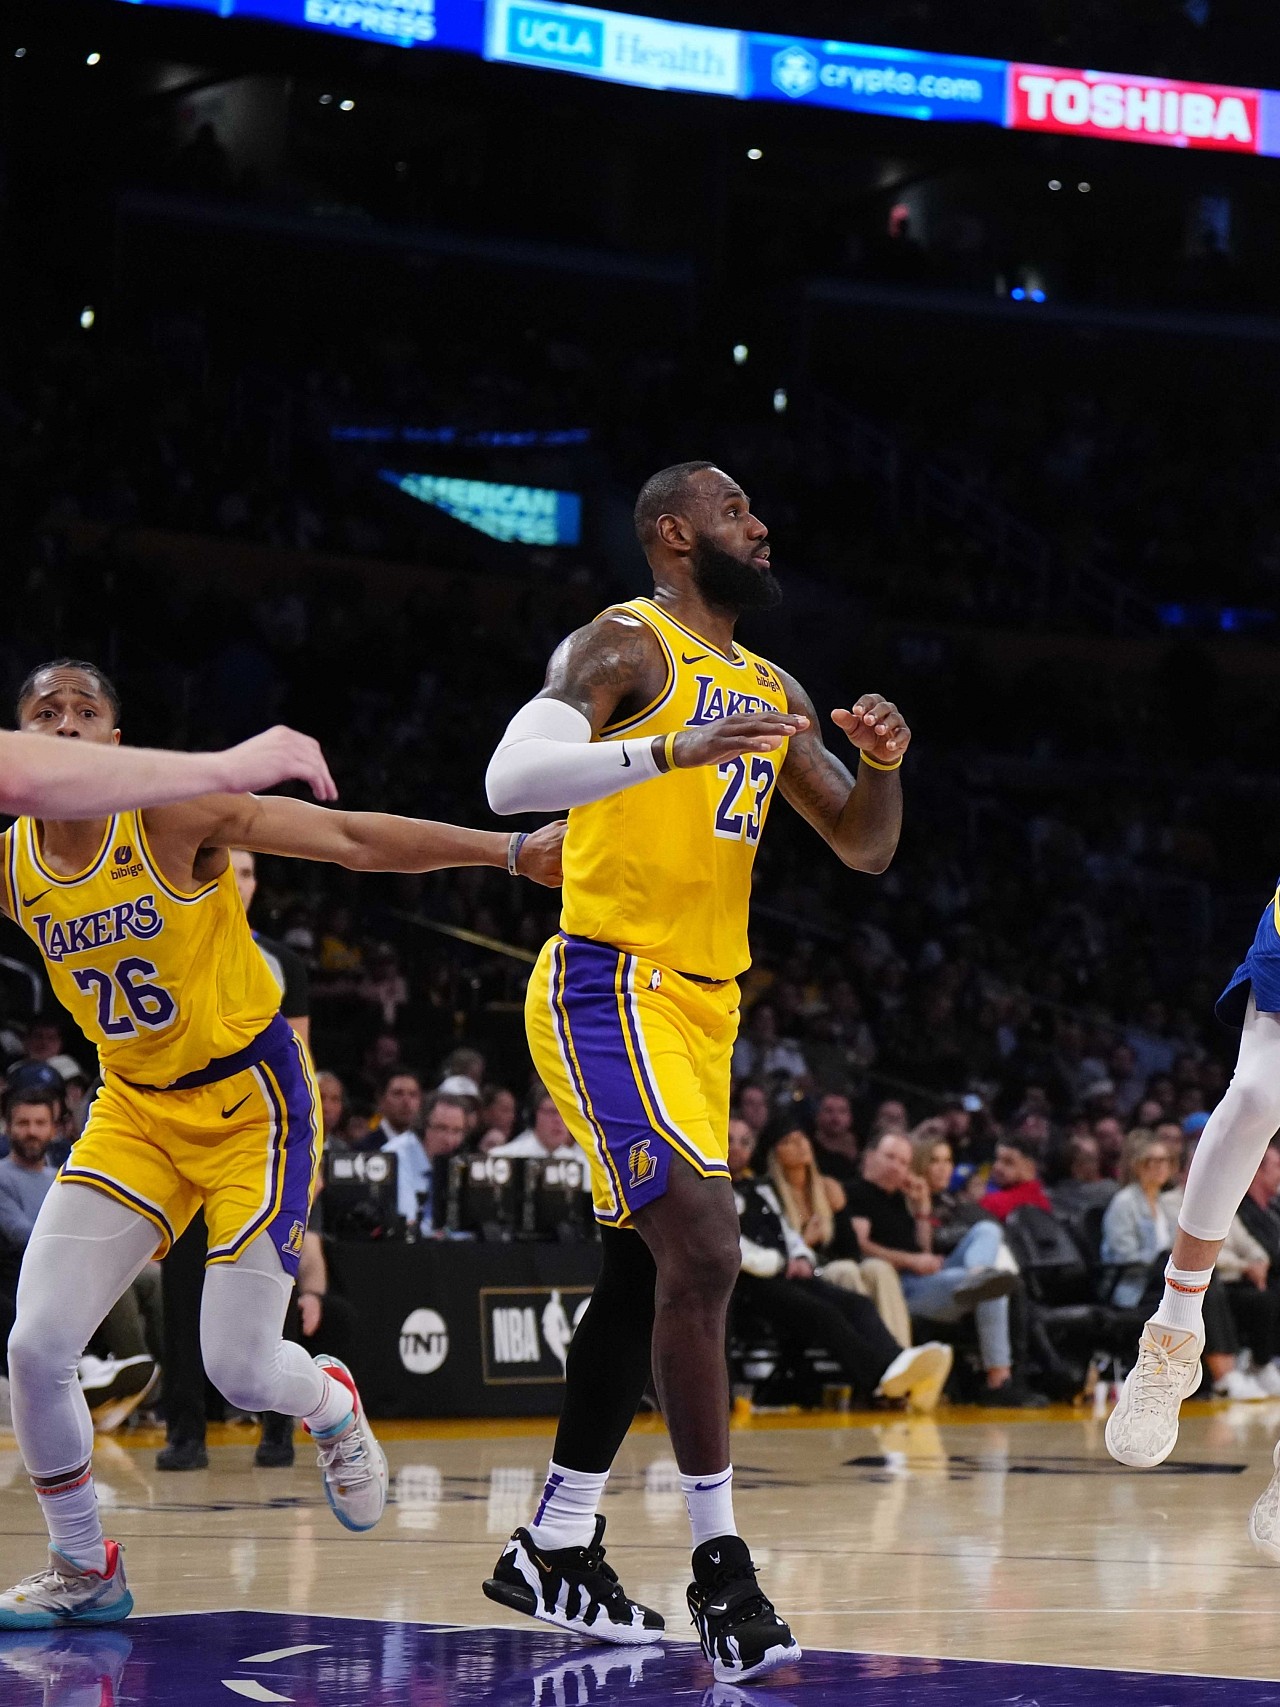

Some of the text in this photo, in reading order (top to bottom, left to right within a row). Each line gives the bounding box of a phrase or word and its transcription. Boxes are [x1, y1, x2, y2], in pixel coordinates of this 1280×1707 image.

[517, 16, 725, 76] UCLA Health
[820, 63, 983, 103] crypto.com
[1017, 75, 1253, 143] TOSHIBA
[713, 754, 776, 847] 23
[110, 861, 144, 881] bibigo
[33, 894, 164, 963] LAKERS
[71, 955, 179, 1041] 26
[492, 1306, 541, 1364] NBA
